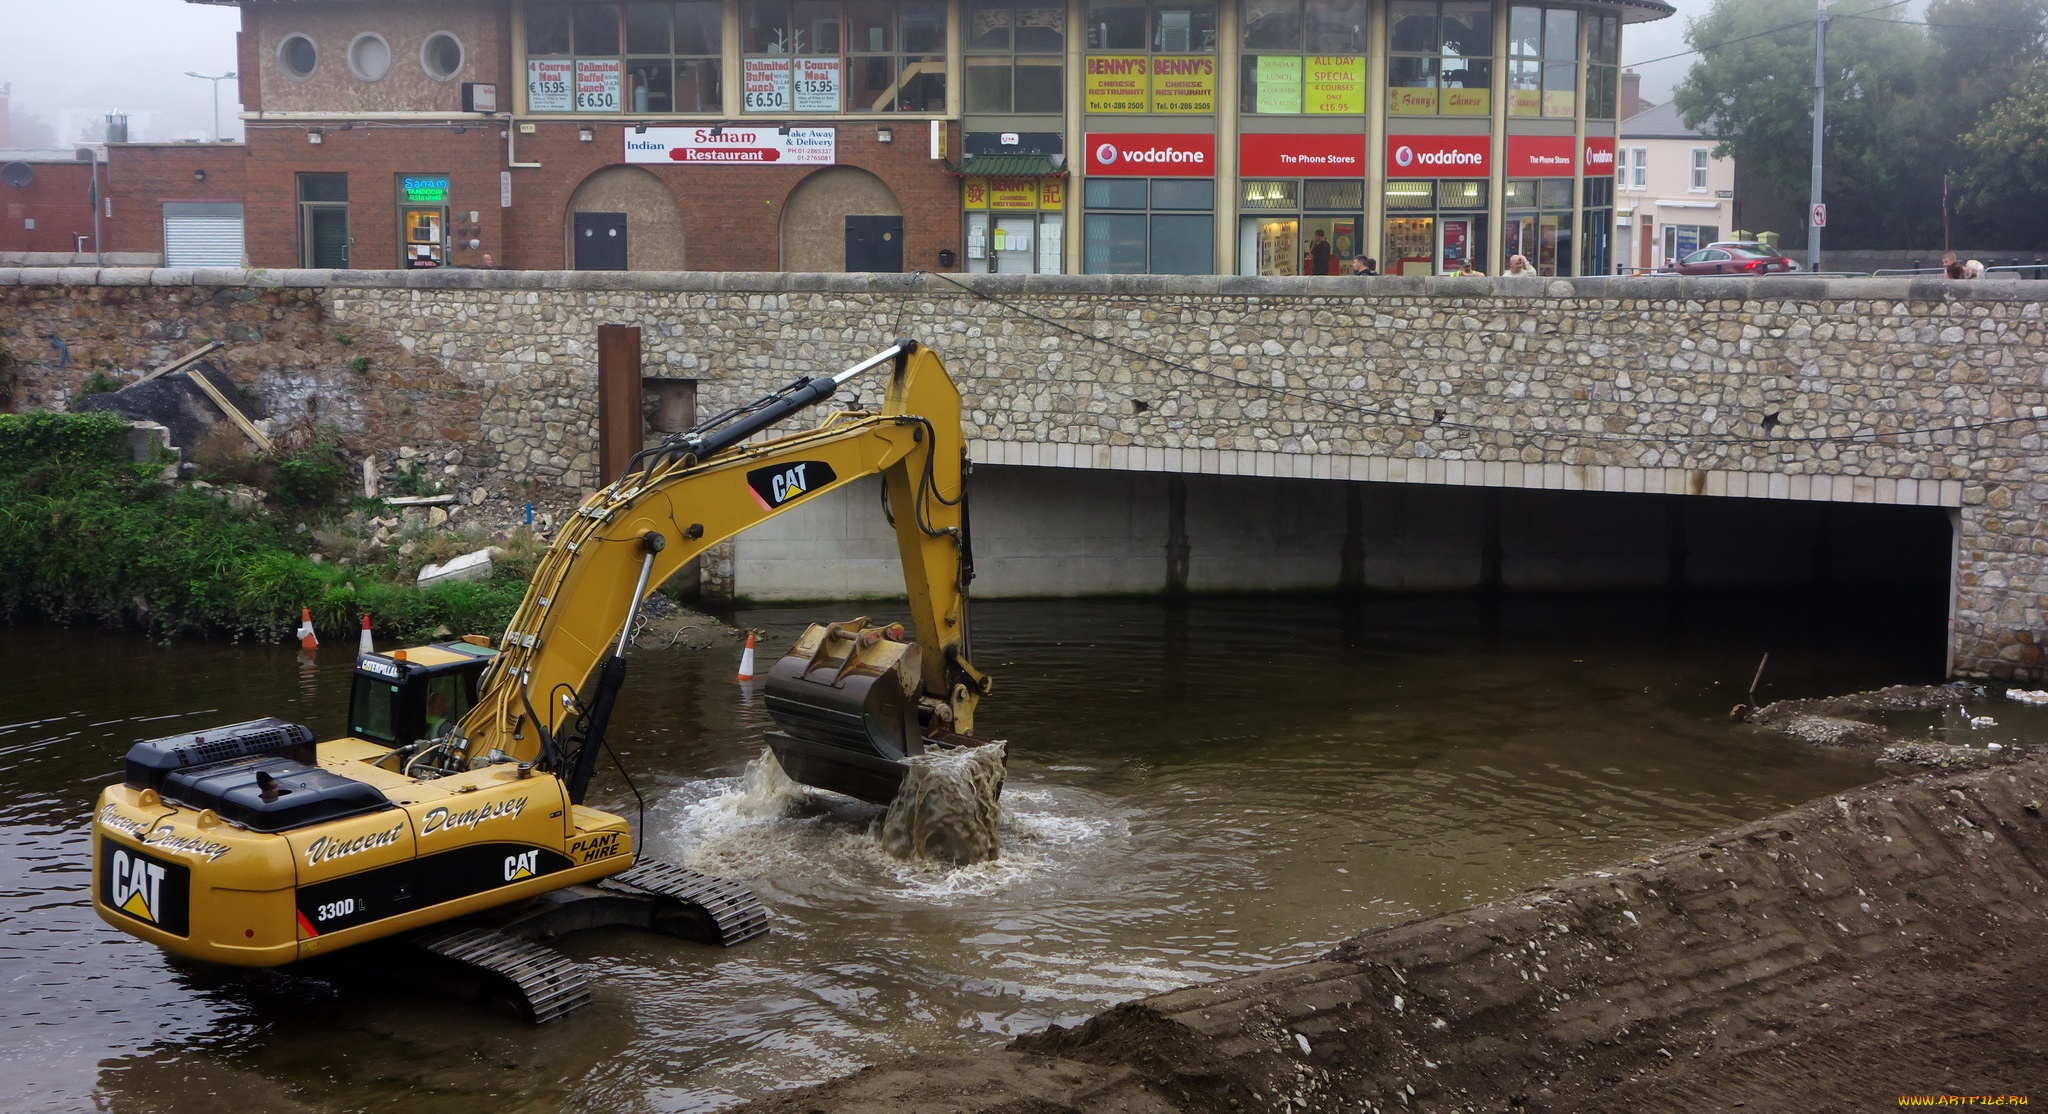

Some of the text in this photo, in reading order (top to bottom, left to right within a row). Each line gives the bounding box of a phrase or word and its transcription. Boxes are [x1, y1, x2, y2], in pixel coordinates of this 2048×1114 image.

[528, 62, 570, 71] 4 Course
[746, 62, 788, 71] Unlimited
[794, 60, 839, 70] 4 Course
[1088, 58, 1146, 74] BENNY'S
[1314, 57, 1355, 65] ALL DAY
[578, 62, 618, 72] Unlimited
[1154, 59, 1212, 75] BENNY'S
[539, 72, 561, 81] Meal
[578, 73, 604, 82] Buffet
[746, 72, 774, 81] Buffet
[804, 71, 828, 80] Meal
[1314, 72, 1354, 80] SPECIAL
[539, 82, 565, 93] 15.95
[578, 83, 604, 92] Lunch
[746, 82, 774, 92] Lunch
[804, 81, 832, 92] 15.95
[577, 93, 584, 107] €
[587, 93, 612, 107] 6.50
[746, 93, 753, 107] €
[756, 92, 782, 107] 6.50
[1403, 93, 1436, 107] Benny's
[1450, 94, 1481, 106] Chinese
[694, 129, 756, 145] Sanam
[809, 130, 833, 138] Away
[627, 141, 665, 150] Indian
[797, 138, 832, 147] Delivery
[686, 149, 763, 160] Restaurant
[1122, 147, 1204, 163] vodafone
[1328, 155, 1355, 163] Stores
[1417, 150, 1482, 164] vodafone
[1592, 150, 1612, 163] vodafone
[404, 178, 448, 189] Sanam
[992, 180, 1034, 192] BENNY'S
[1042, 183, 1061, 204] 記
[772, 463, 806, 502] CAT
[97, 803, 232, 863] Vincent Dempsey
[304, 796, 528, 866] Vincent Dempsey
[570, 833, 619, 854] PLANT
[583, 844, 619, 862] HIRE
[504, 850, 539, 881] CAT
[112, 850, 165, 924] CAT
[318, 898, 354, 921] 330D
